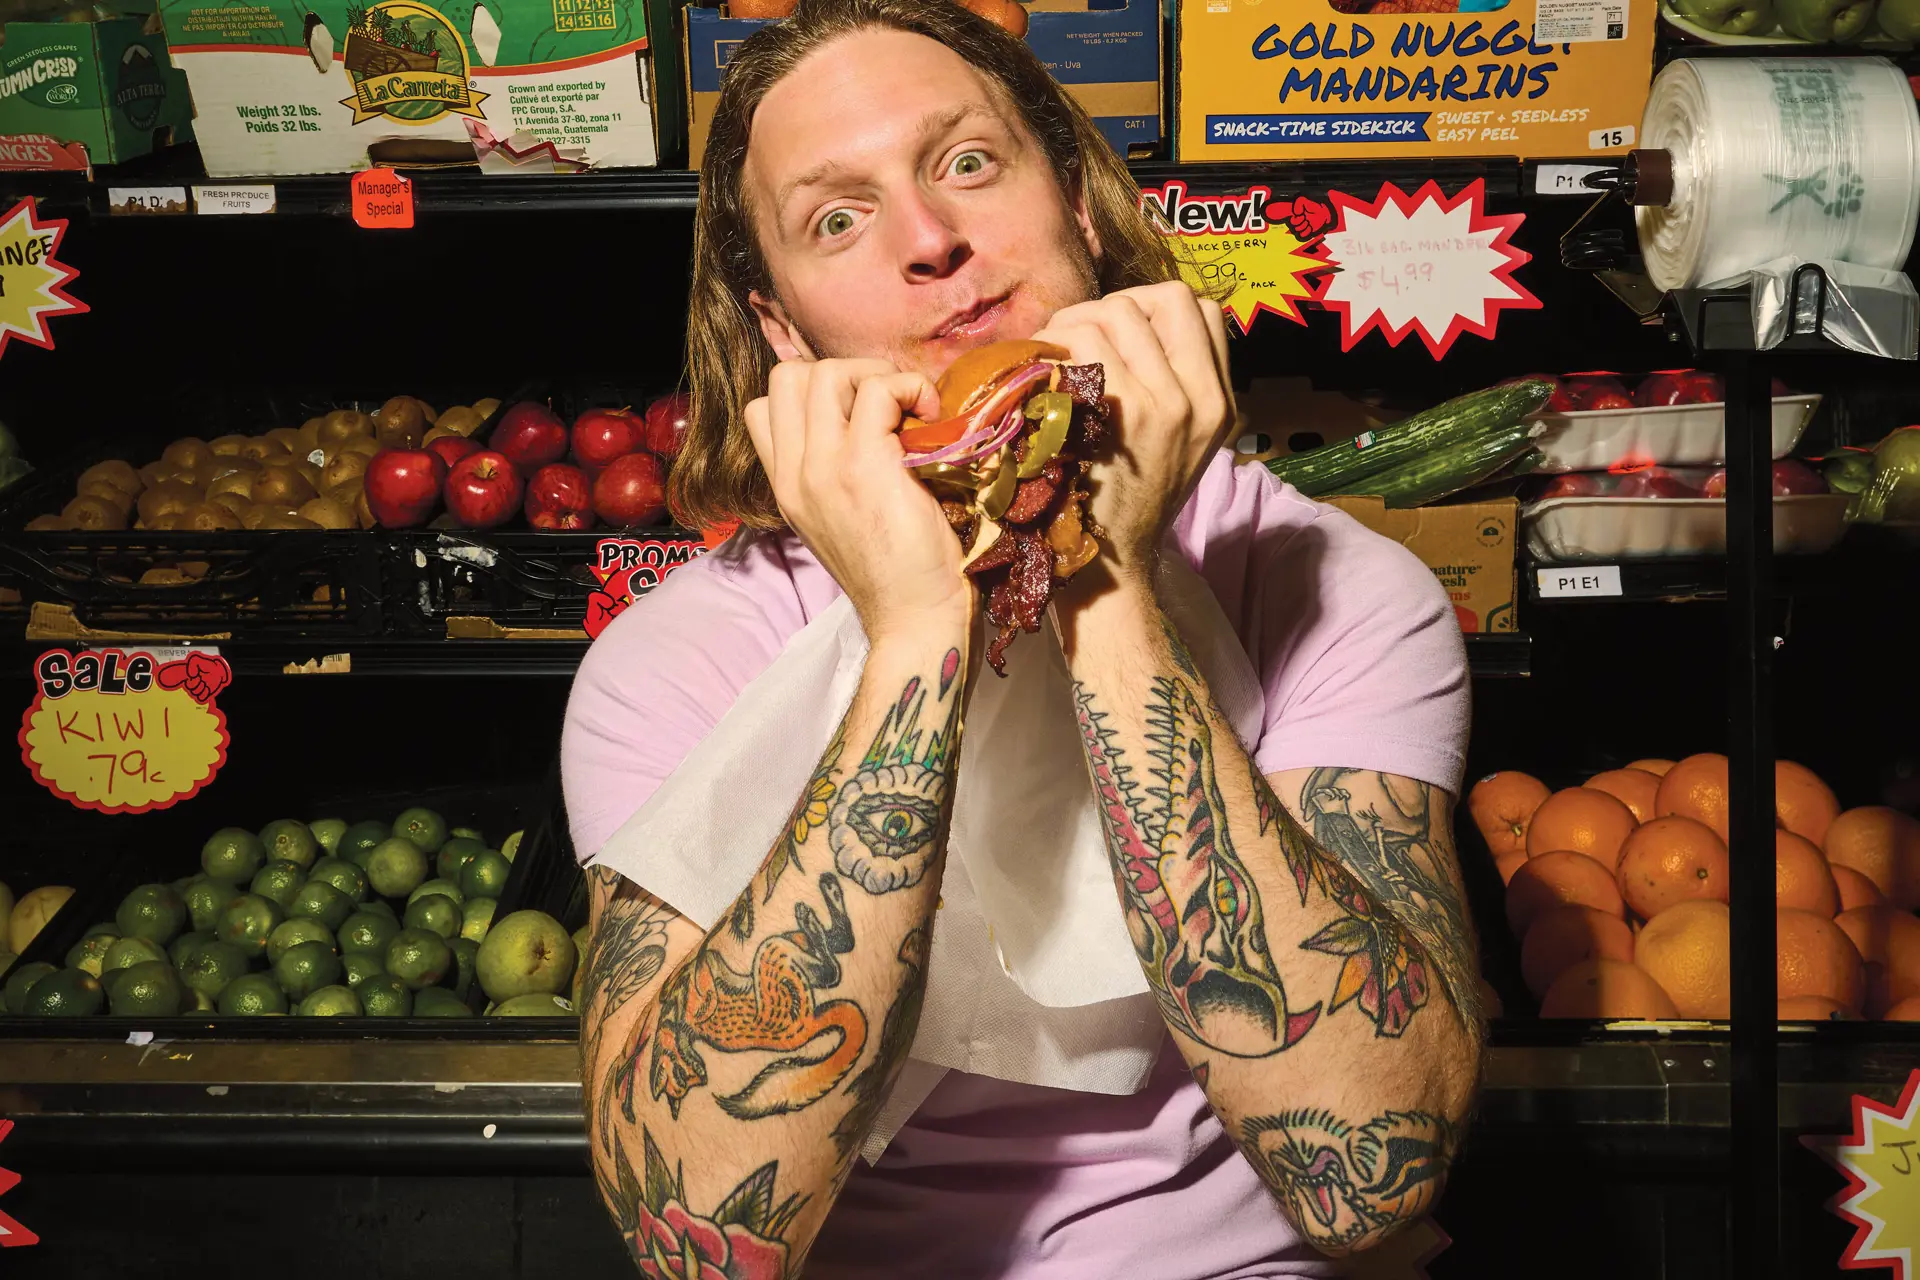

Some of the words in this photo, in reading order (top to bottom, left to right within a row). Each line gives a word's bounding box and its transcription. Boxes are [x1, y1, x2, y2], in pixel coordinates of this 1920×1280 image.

[191, 8, 204, 16] NOT
[205, 7, 218, 15] FOR
[219, 6, 260, 15] IMPORTATION
[558, 0, 571, 11] 11
[576, 0, 591, 10] 12
[597, 0, 610, 9] 13
[559, 17, 574, 28] 14
[578, 15, 592, 27] 15
[597, 14, 612, 26] 16
[1252, 21, 1375, 60] GOLD
[7, 55, 25, 68] GREEN
[25, 45, 53, 59] SEEDLESS
[1065, 60, 1082, 69] Uva
[508, 84, 536, 94] Grown
[538, 83, 554, 92] and
[556, 81, 593, 92] exported
[595, 81, 606, 91] by
[1279, 62, 1559, 104] MANDARINS
[509, 94, 539, 105] Cultivé
[541, 94, 550, 103] et
[551, 92, 584, 104] exporté
[585, 92, 600, 102] par
[236, 105, 280, 120] Weight
[281, 104, 298, 117] 32
[298, 104, 322, 116] lbs.
[511, 106, 528, 115] FPC
[529, 105, 559, 116] Group,
[559, 104, 577, 114] S.A.
[1436, 110, 1495, 125] SWEET
[1511, 108, 1590, 123] SEEDLESS
[513, 117, 523, 126] 11
[525, 115, 559, 125] Avenida
[560, 114, 589, 124] 37-80,
[589, 113, 610, 123] zona
[611, 112, 622, 121] 11
[1124, 120, 1140, 129] CAT
[1141, 120, 1146, 128] 1
[245, 121, 280, 134] Poids
[281, 120, 298, 132] 32
[298, 120, 322, 132] lbs.
[563, 125, 609, 134] Guatemala
[1213, 121, 1326, 137] SNACK-TIME
[1331, 120, 1416, 136] SIDEKICK
[1436, 128, 1477, 142] EASY
[1480, 127, 1520, 141] PEEL
[1600, 131, 1623, 147] 15
[1556, 175, 1573, 188] P1
[202, 190, 229, 198] FRESH
[231, 191, 270, 200] PRODUCE
[222, 200, 251, 209] FRUITS
[367, 201, 404, 219] Special
[1143, 187, 1267, 230] New!
[1251, 280, 1277, 289] PACK
[1558, 578, 1576, 590] P1
[1582, 576, 1600, 589] E1
[158, 649, 190, 657] BEVER
[56, 706, 170, 744] KIWI
